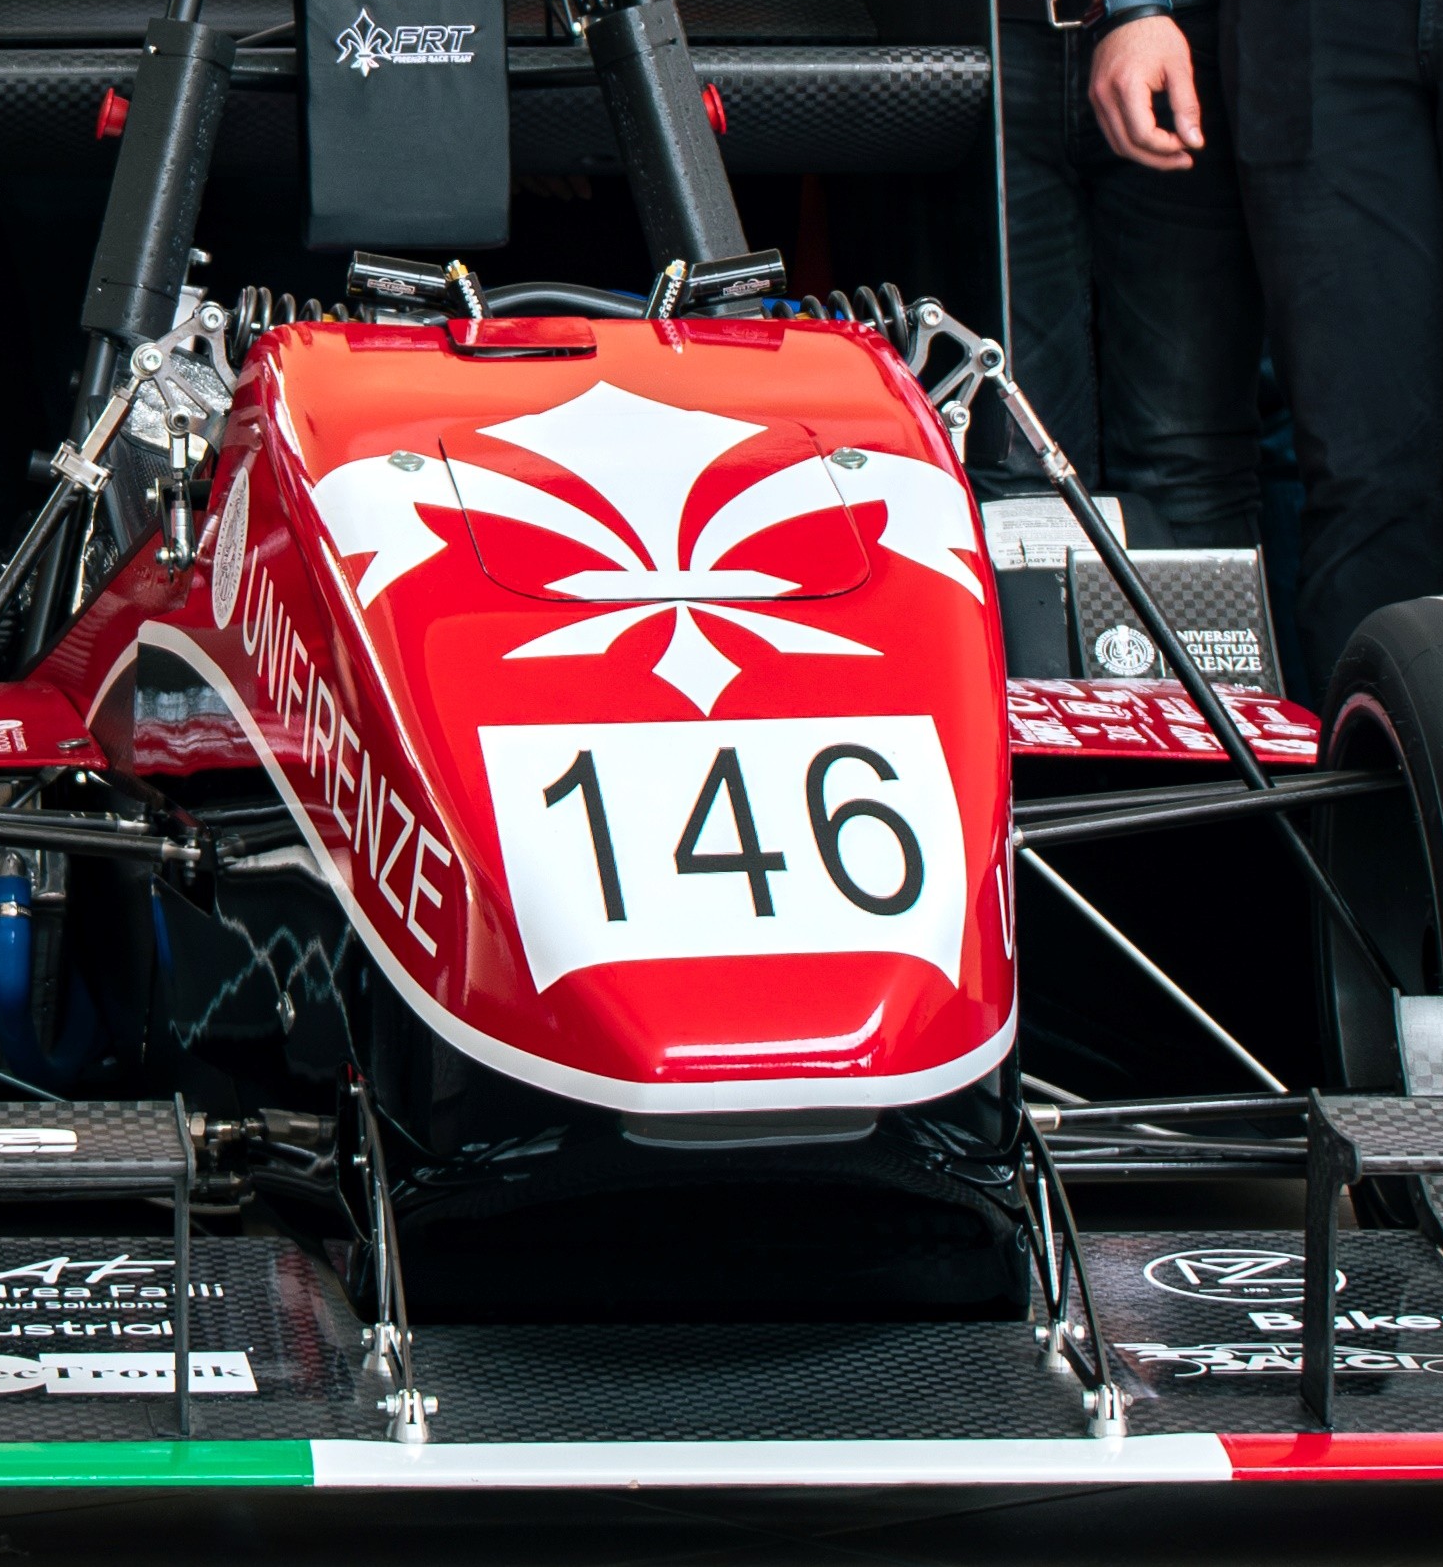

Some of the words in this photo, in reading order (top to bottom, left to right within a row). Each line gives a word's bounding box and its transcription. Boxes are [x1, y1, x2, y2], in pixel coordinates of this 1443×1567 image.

[392, 25, 475, 53] FRT
[1176, 628, 1257, 643] NIVERSITÀ
[1187, 644, 1212, 655] GLI
[1214, 644, 1259, 655] STUDI
[1198, 656, 1262, 672] RENZE
[243, 545, 451, 958] UNIFIRENZE
[543, 743, 925, 922] 146
[49, 1301, 168, 1311] Solutions
